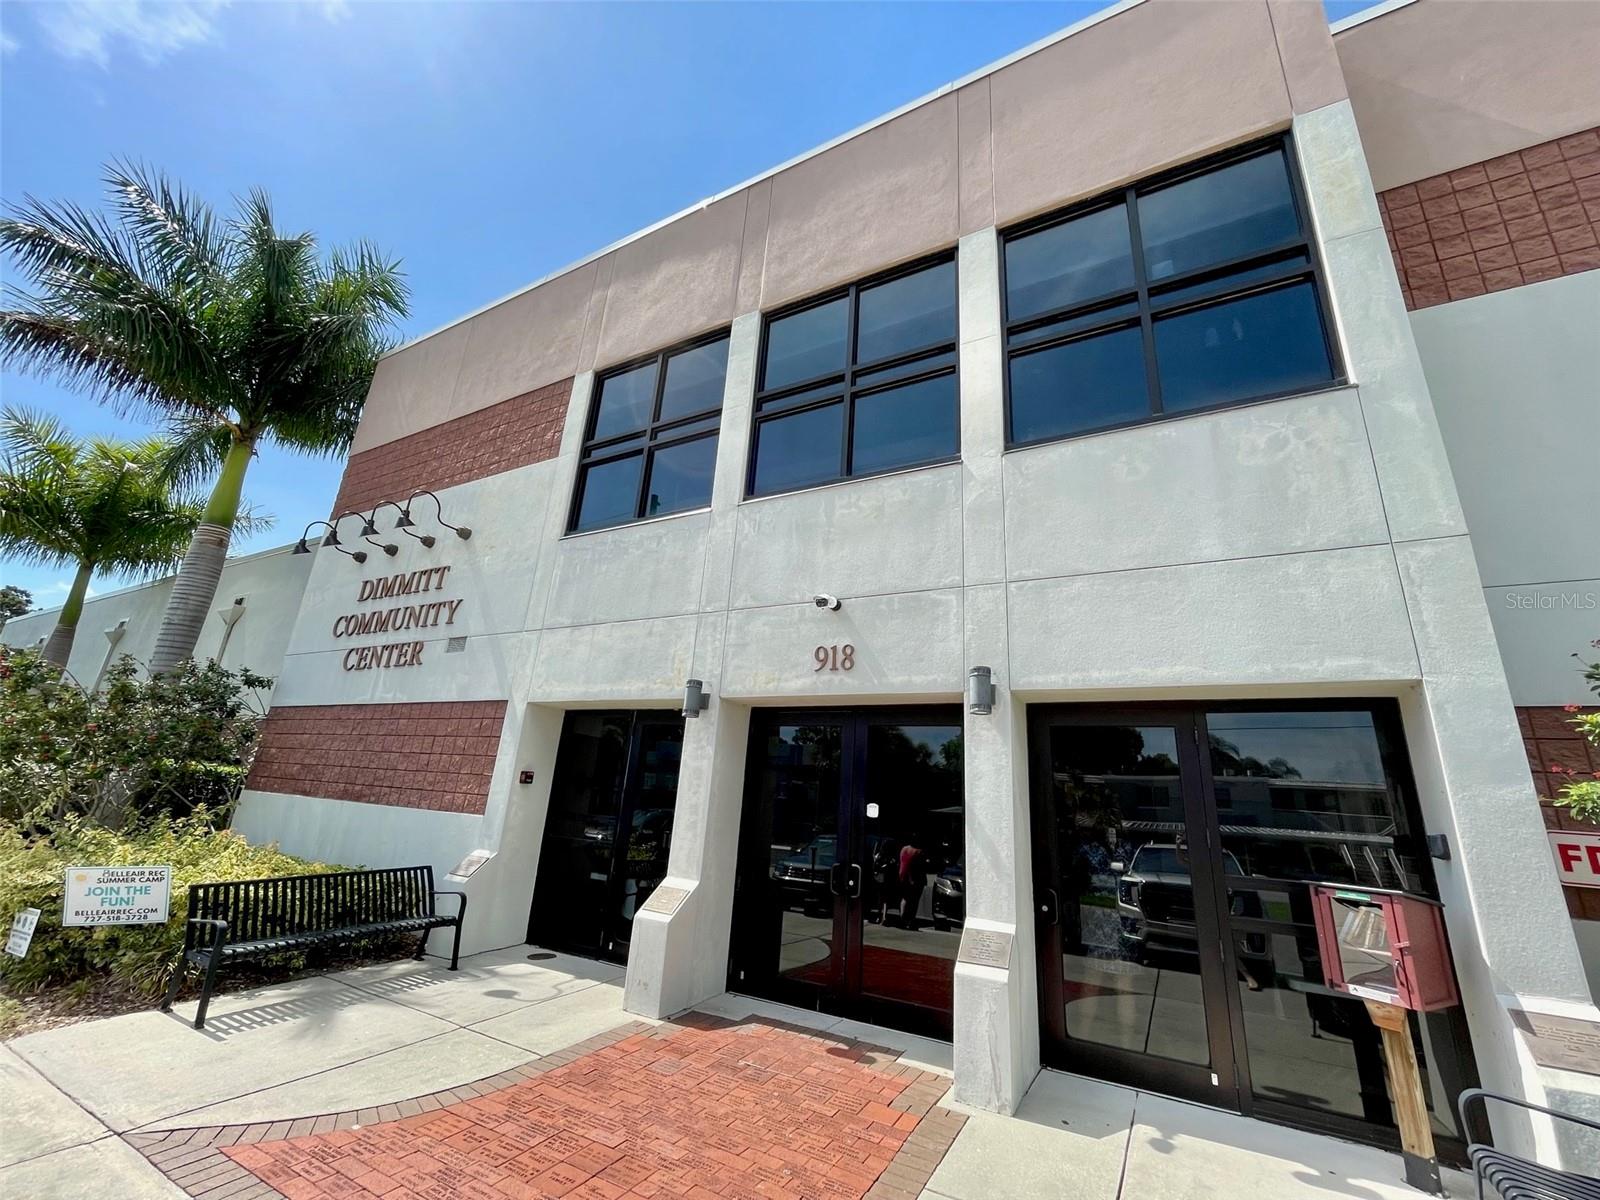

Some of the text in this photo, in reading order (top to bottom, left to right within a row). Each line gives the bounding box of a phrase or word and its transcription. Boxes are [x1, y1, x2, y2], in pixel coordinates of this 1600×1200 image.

[357, 565, 451, 602] DIMMITT
[332, 598, 464, 638] COMMUNITY
[343, 640, 425, 672] CENTER
[814, 644, 855, 672] 918
[103, 869, 146, 878] BELLEAIR
[84, 885, 152, 897] JOIN THE
[100, 896, 136, 907] FUN!
[74, 908, 159, 917] BELLEAIRREC.COM
[83, 914, 149, 922] 727-518-3728
